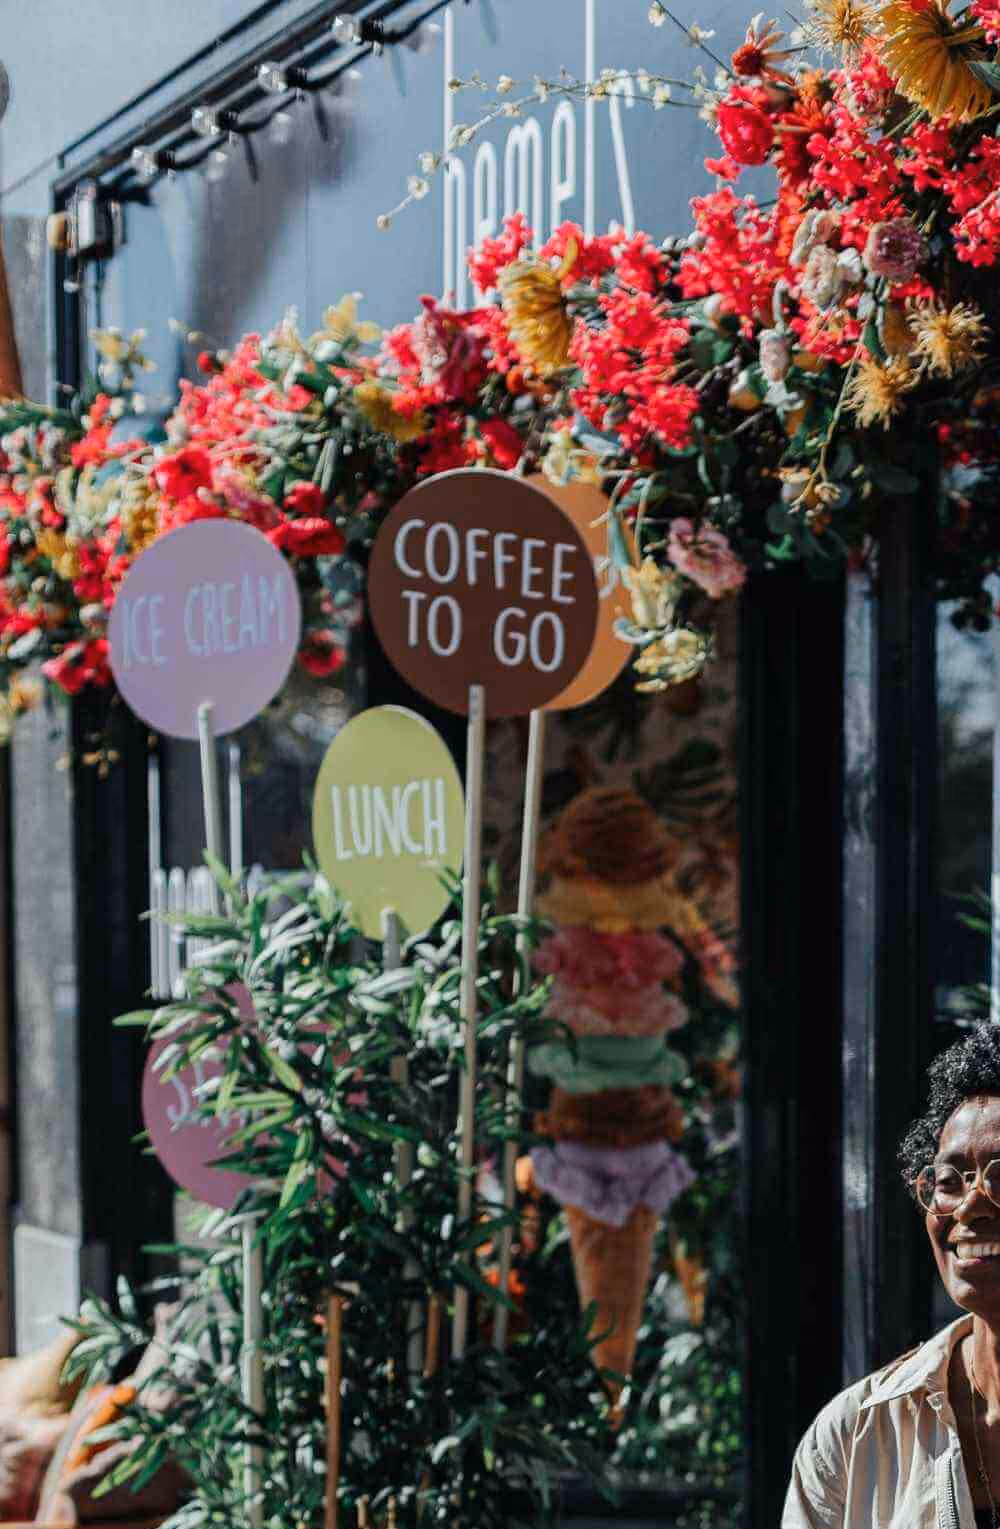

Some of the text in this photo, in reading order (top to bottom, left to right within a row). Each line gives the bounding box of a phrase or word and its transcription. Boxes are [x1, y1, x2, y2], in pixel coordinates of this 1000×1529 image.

[393, 518, 577, 605] COFFEE
[122, 573, 290, 669] ICE CREAM
[400, 589, 565, 673] TO GO
[330, 776, 448, 861] LUNCH
